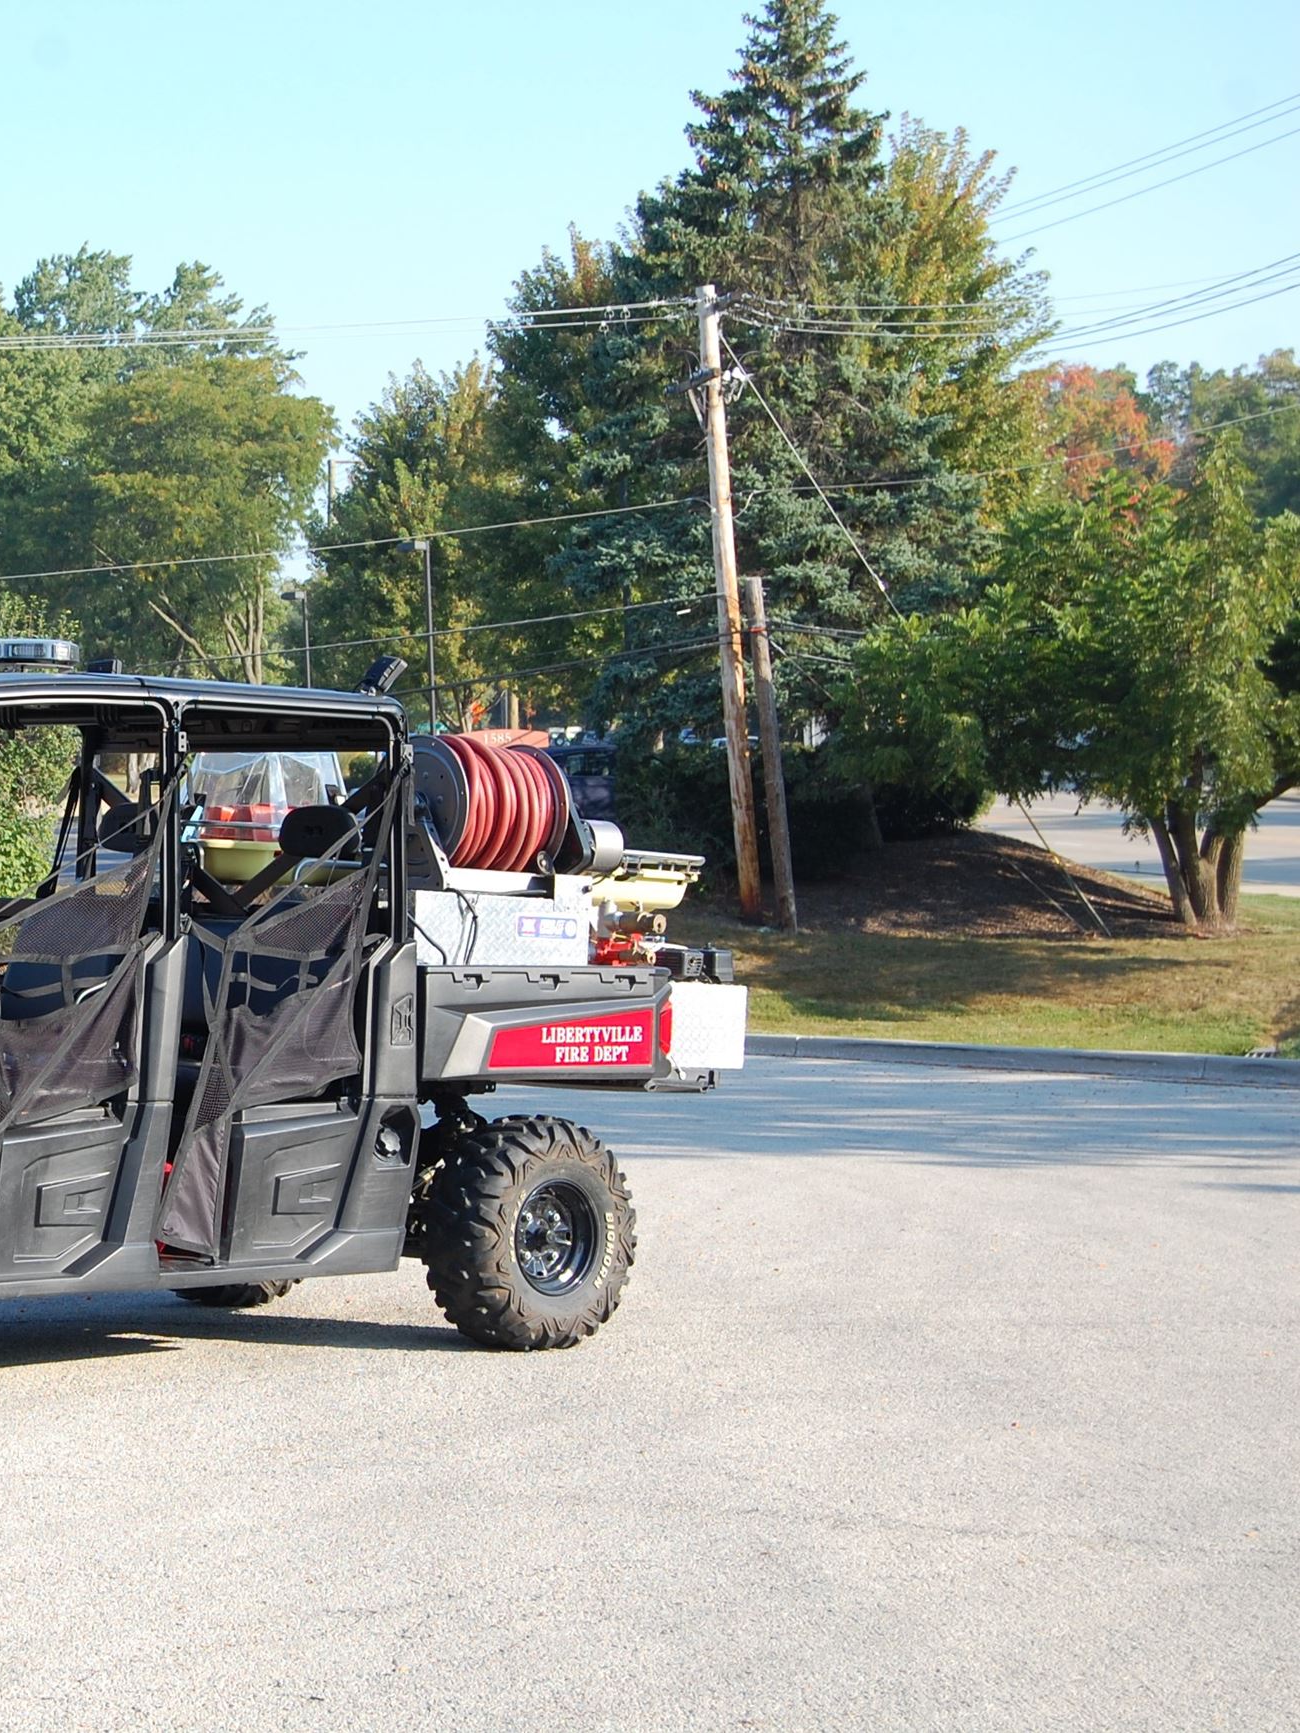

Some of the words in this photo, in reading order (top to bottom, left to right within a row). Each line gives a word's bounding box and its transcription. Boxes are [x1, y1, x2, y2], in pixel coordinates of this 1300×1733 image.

[483, 732, 512, 746] 1585
[541, 1025, 643, 1044] LIBERTYVILLE
[554, 1045, 590, 1063] FIRE
[593, 1045, 629, 1063] DEPT
